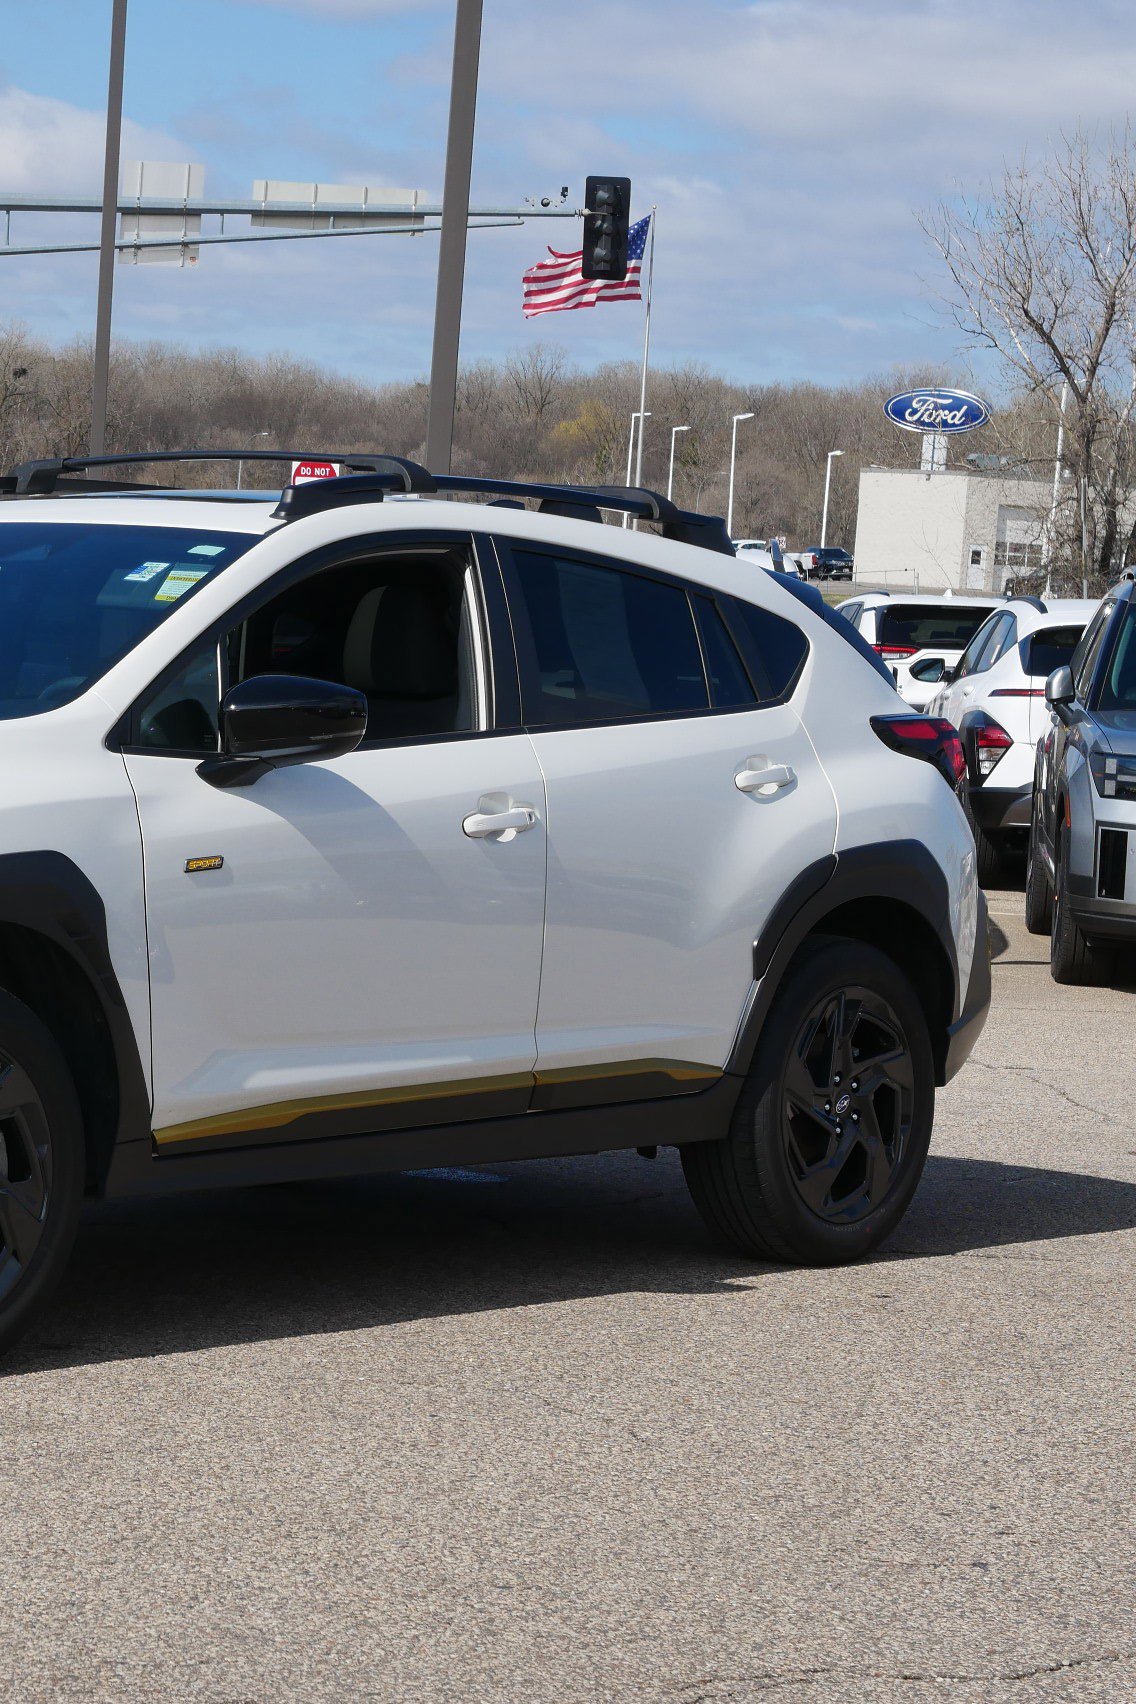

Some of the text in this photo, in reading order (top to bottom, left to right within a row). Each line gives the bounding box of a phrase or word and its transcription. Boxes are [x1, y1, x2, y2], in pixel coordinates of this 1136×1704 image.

[905, 396, 968, 424] Ford
[300, 467, 330, 476] DO NOT
[188, 857, 222, 870] SPORT
